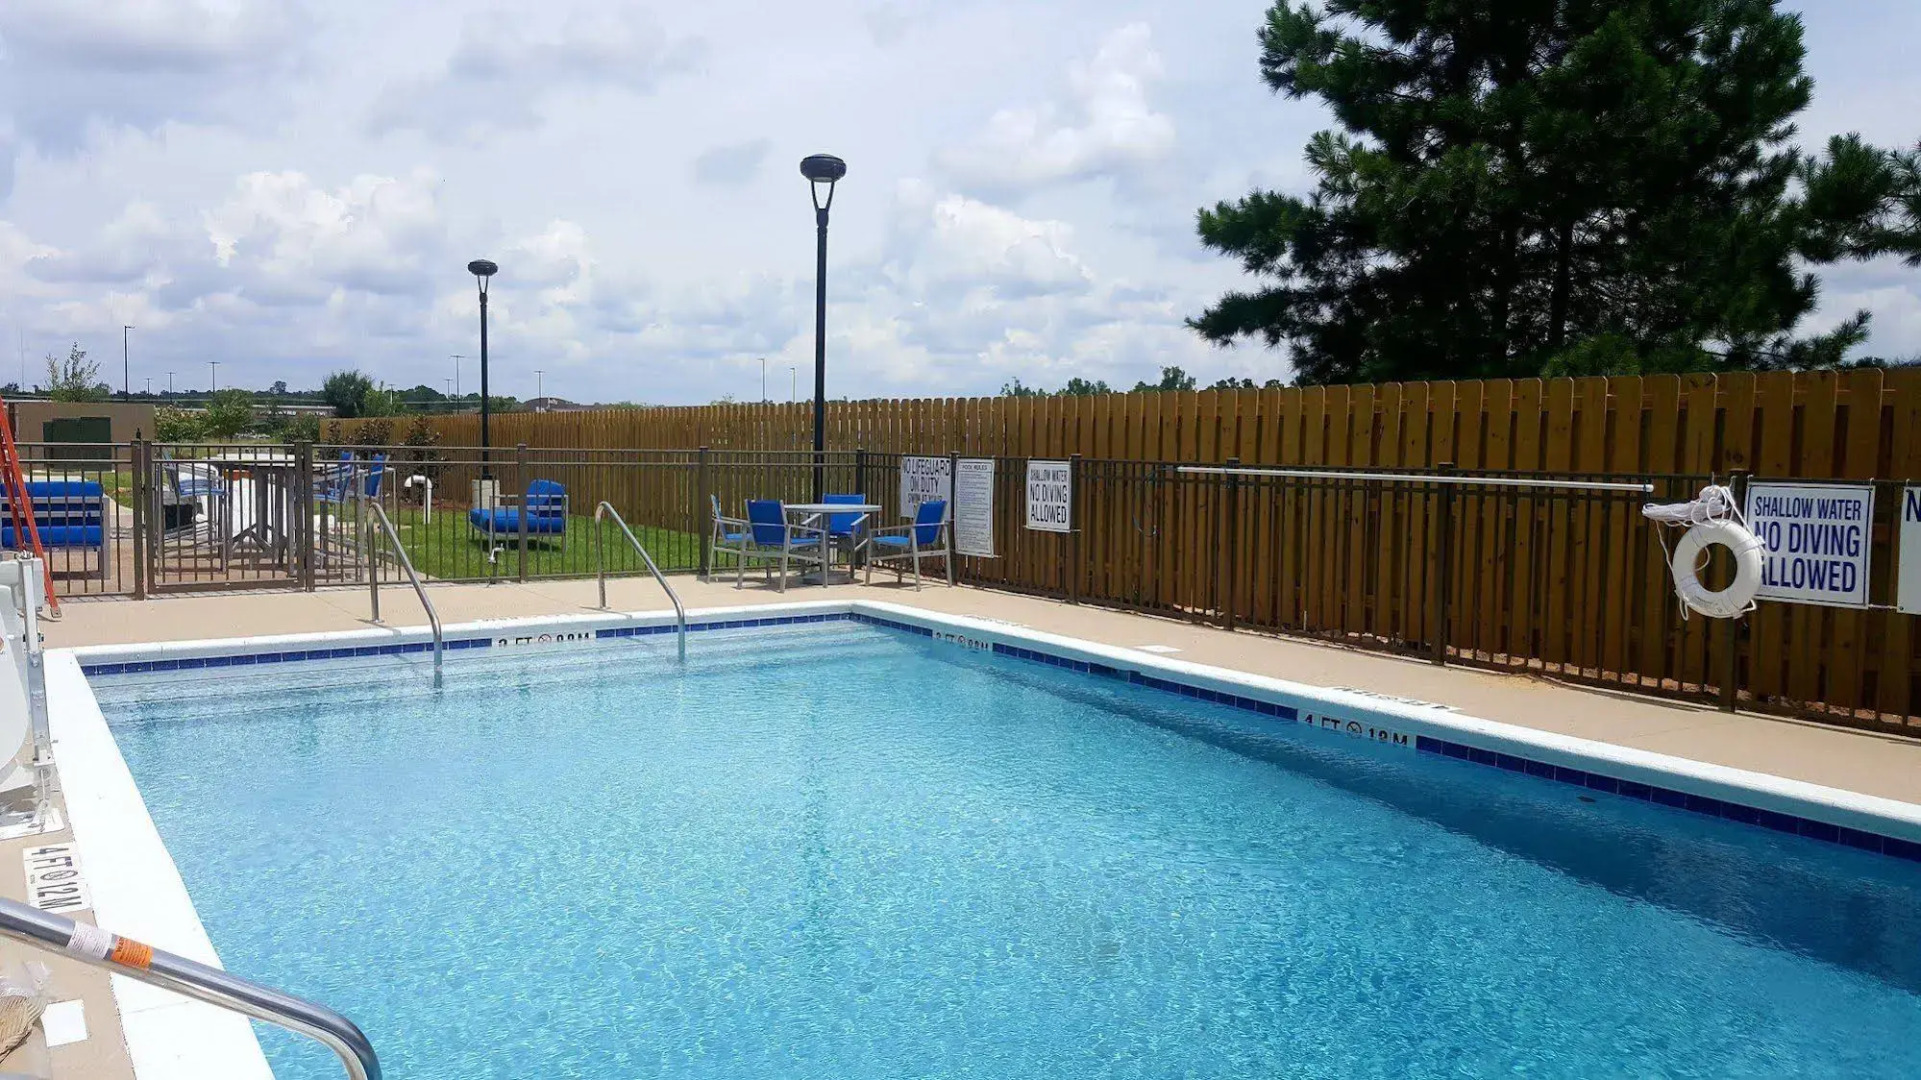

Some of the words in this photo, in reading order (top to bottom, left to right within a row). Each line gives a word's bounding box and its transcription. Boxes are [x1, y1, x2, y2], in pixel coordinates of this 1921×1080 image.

[912, 459, 950, 476] LIFEGUARD
[1051, 470, 1068, 482] WATER
[921, 476, 939, 493] DUTY
[1030, 483, 1039, 502] NO
[1042, 484, 1067, 503] DIVING
[1031, 504, 1067, 523] ALLOWED
[1754, 496, 1813, 518] SHALLOW
[1817, 498, 1862, 521] WATER
[1754, 521, 1781, 552] NO
[1788, 522, 1861, 557] DIVING
